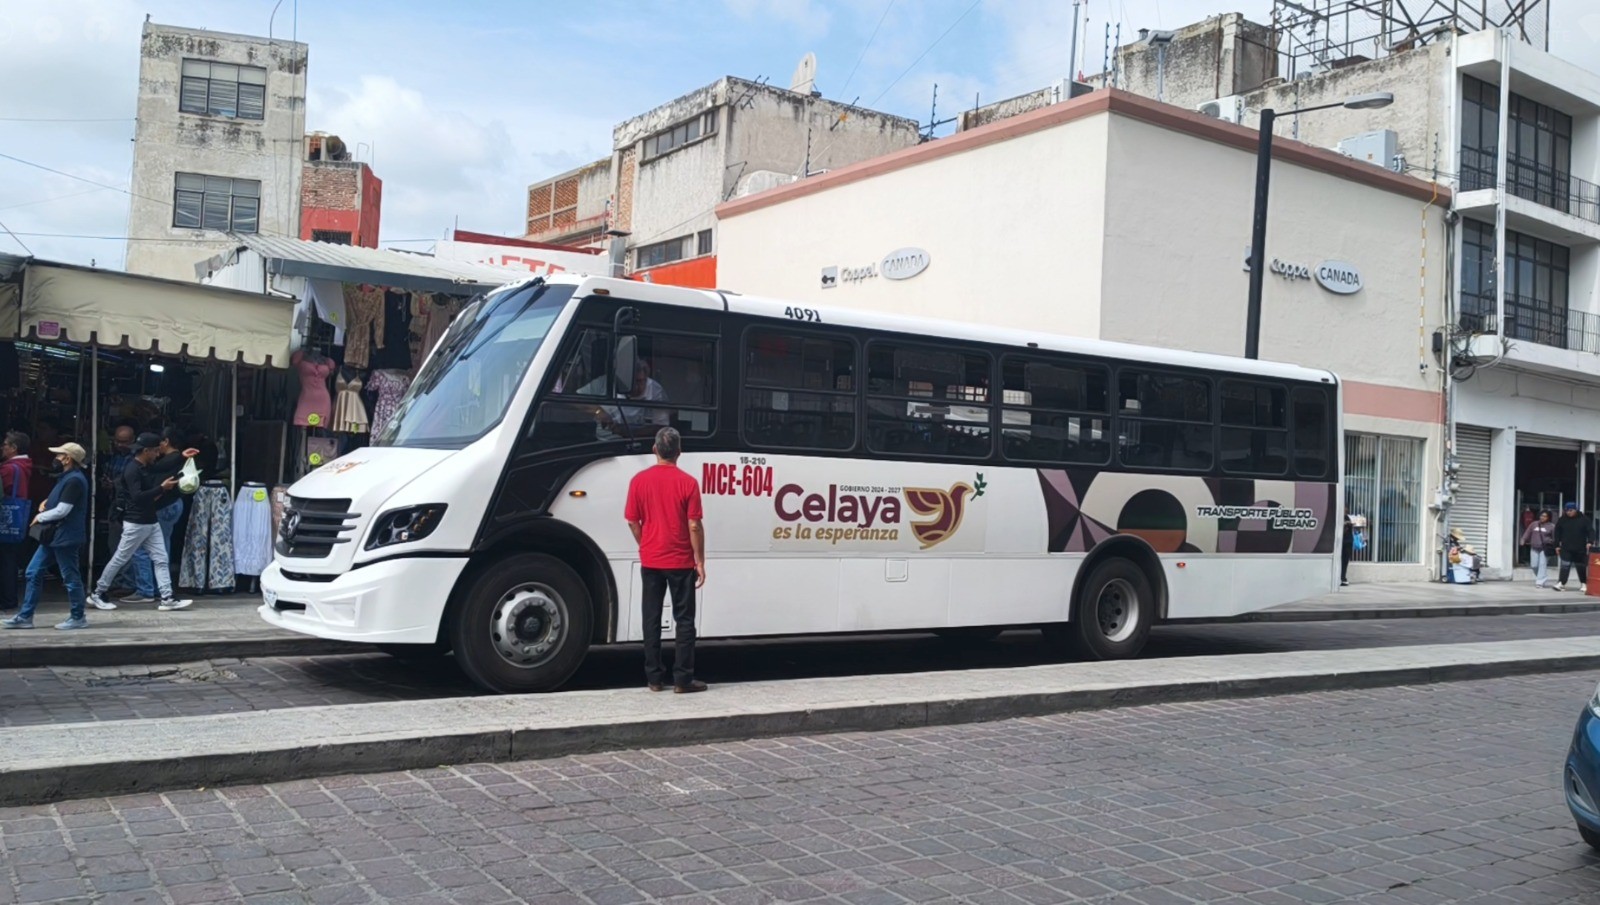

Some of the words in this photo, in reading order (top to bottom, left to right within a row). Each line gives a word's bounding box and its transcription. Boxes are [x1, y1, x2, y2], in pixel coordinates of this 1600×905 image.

[883, 254, 923, 273] CANADA
[841, 263, 878, 284] Coppel
[1319, 267, 1360, 286] CANADA
[784, 306, 822, 323] 4091
[740, 456, 766, 465] 15-210
[702, 462, 773, 497] MCE-604
[839, 485, 870, 493] GOBIERNO
[870, 486, 884, 494] 2024
[774, 483, 901, 528] Celaya
[1197, 506, 1268, 518] TRANSPORTE
[1269, 506, 1311, 518] PÚBLICO
[1274, 519, 1316, 528] URBANO
[773, 526, 791, 539] es
[795, 523, 811, 539] la
[815, 527, 898, 545] esperanza
